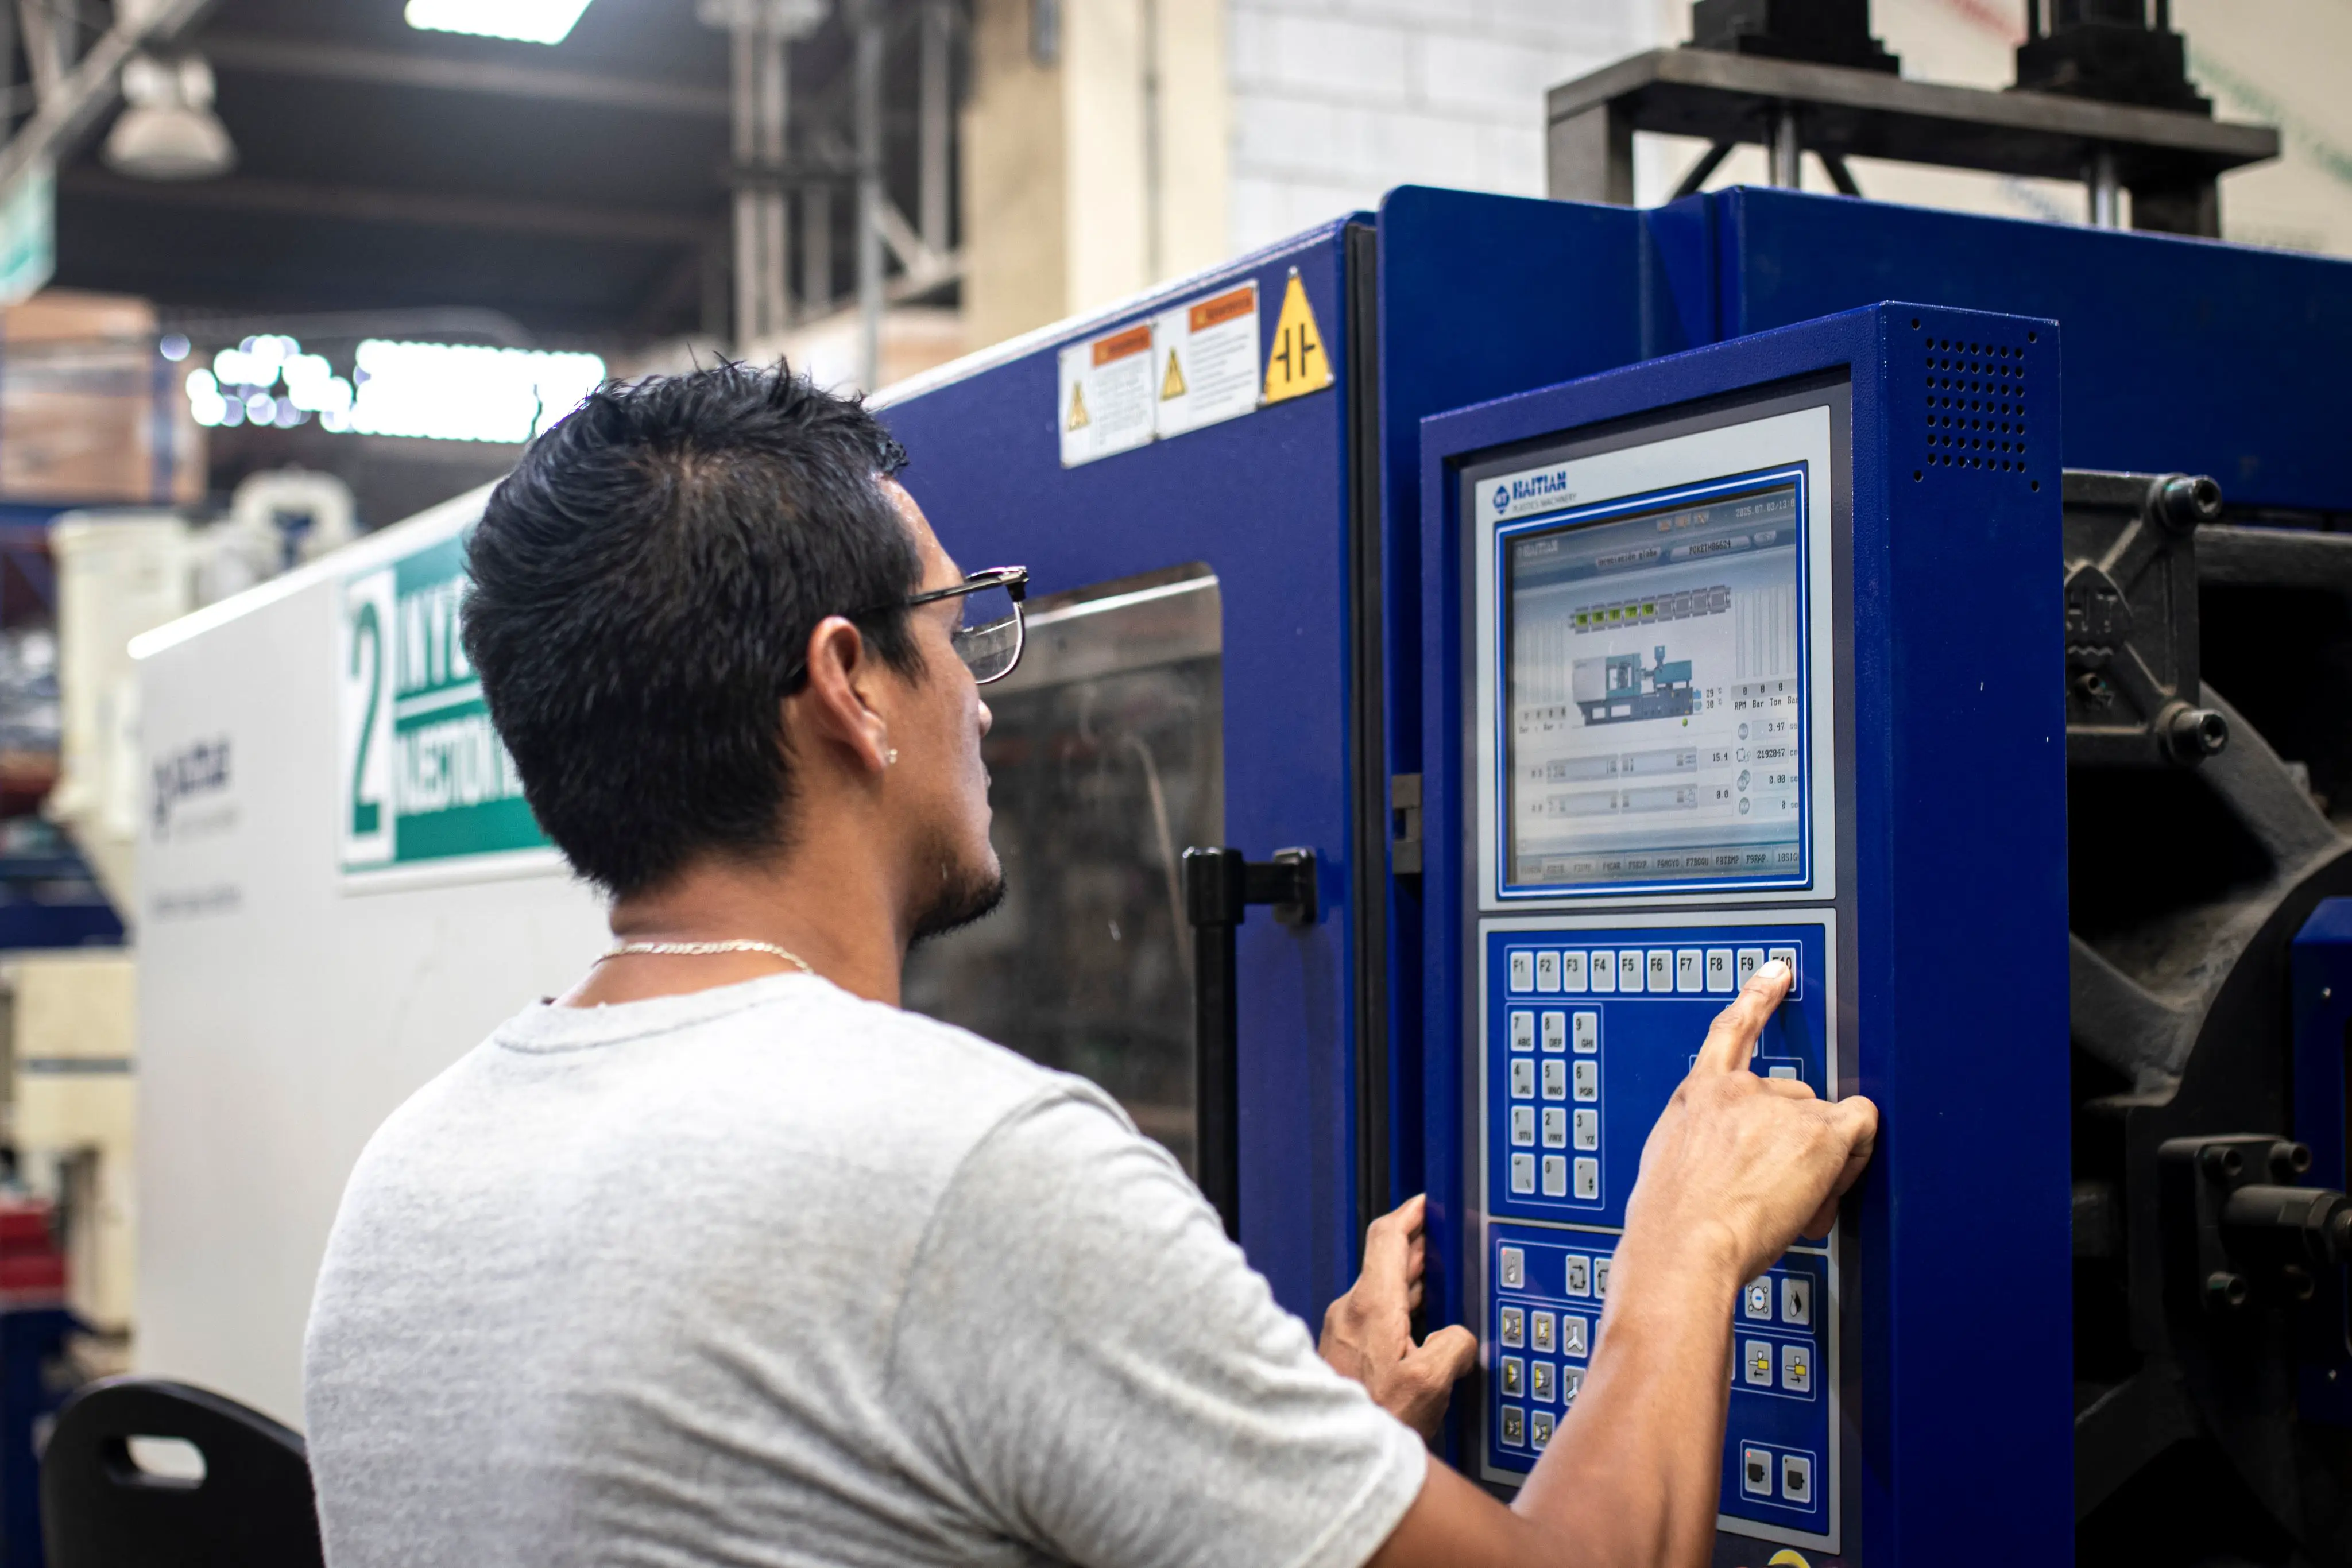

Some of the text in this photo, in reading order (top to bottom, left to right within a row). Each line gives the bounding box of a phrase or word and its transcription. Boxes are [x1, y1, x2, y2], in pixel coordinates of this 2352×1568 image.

[1512, 470, 1566, 500] HAITIAN
[1706, 689, 1714, 698] 29
[1734, 701, 1746, 711] RPM
[1752, 699, 1764, 708] Bar
[1769, 697, 1781, 706] Ton
[1769, 722, 1785, 733] 3.47
[1713, 752, 1728, 762] 15.4
[1716, 789, 1728, 799] 0.0
[1513, 957, 1754, 973] F1 F2 F3 F4 F5 F6 F7 F8 F9
[1514, 1016, 1519, 1029] 7
[1544, 1017, 1549, 1030] 8
[1576, 1018, 1582, 1031] 9
[1518, 1038, 1531, 1047] ABC
[1581, 1039, 1594, 1048] GHI
[1514, 1064, 1520, 1077] 4
[1545, 1065, 1550, 1078] 5
[1576, 1066, 1582, 1079] 6
[1548, 1086, 1563, 1095] MNO
[1515, 1111, 1519, 1125] 1
[1545, 1113, 1551, 1126] 2
[1576, 1114, 1583, 1128] 3
[1585, 1135, 1595, 1145] YZ
[1545, 1160, 1551, 1174] 0
